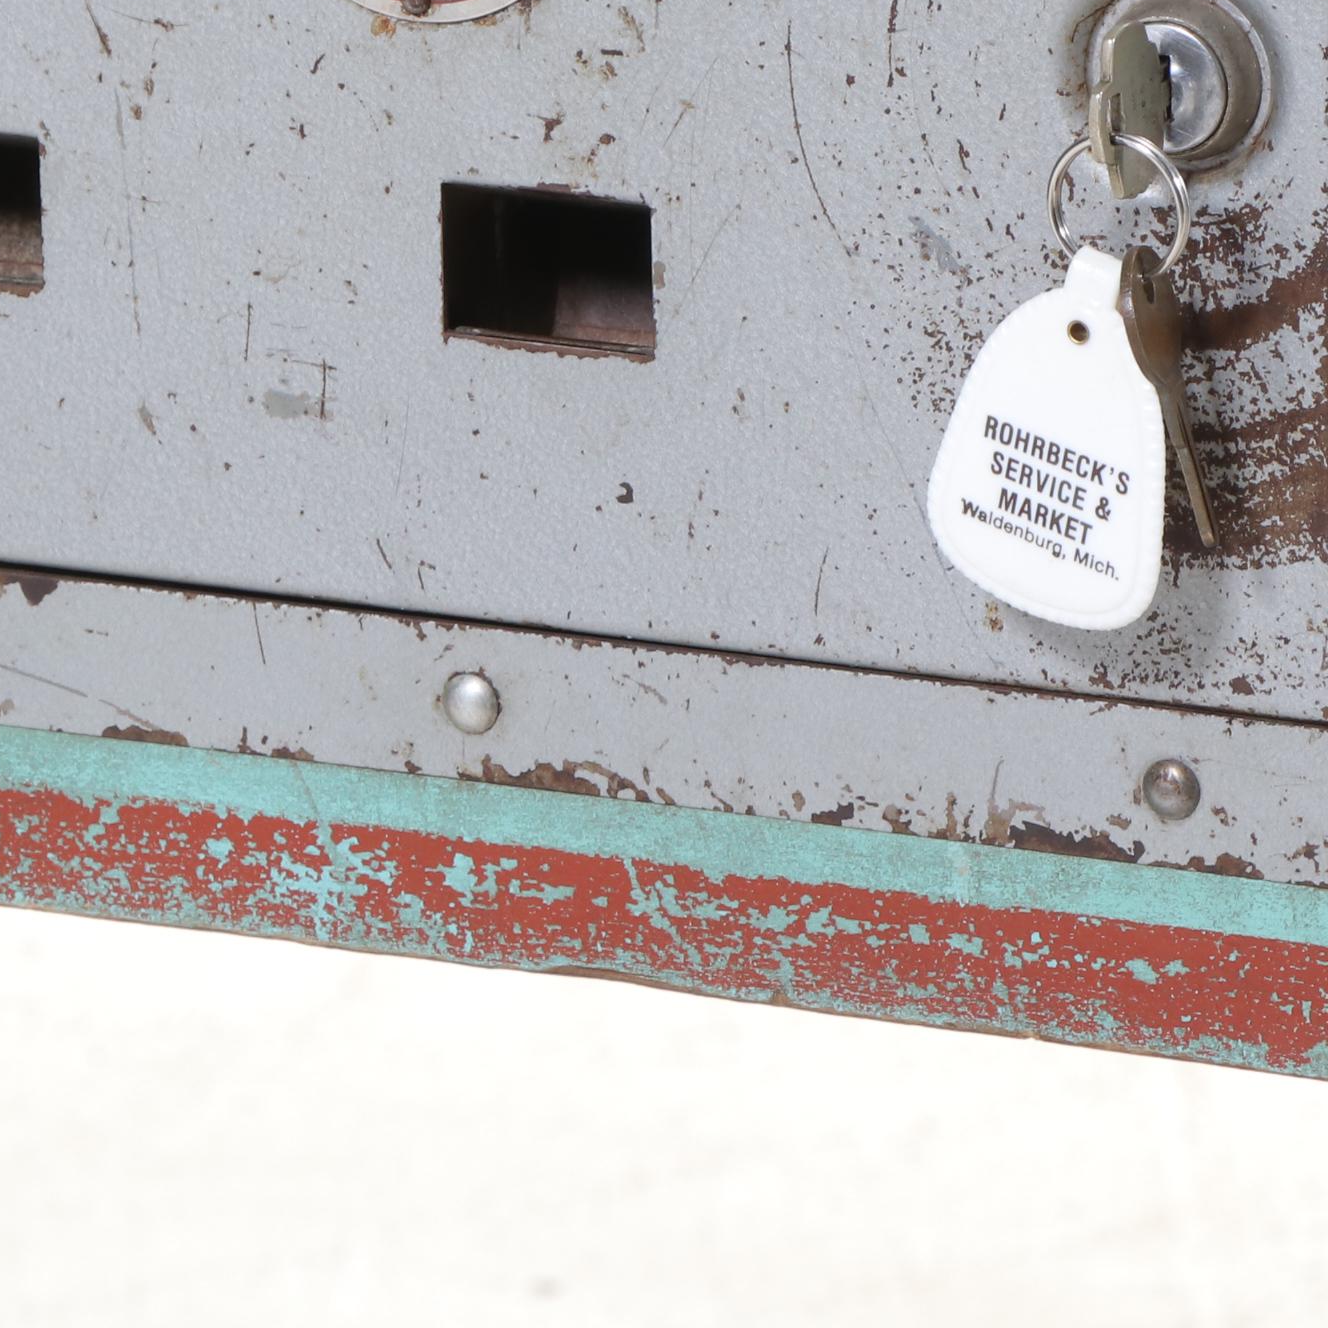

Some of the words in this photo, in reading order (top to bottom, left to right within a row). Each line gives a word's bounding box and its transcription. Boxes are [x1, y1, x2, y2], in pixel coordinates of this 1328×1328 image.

[983, 415, 1130, 495] ROHRBECK'S
[990, 451, 1088, 510] SERVICE
[1094, 497, 1112, 521] &
[960, 498, 1067, 560] Waldenburg,
[1073, 549, 1120, 581] Mich.
[997, 487, 1094, 545] MARKET
